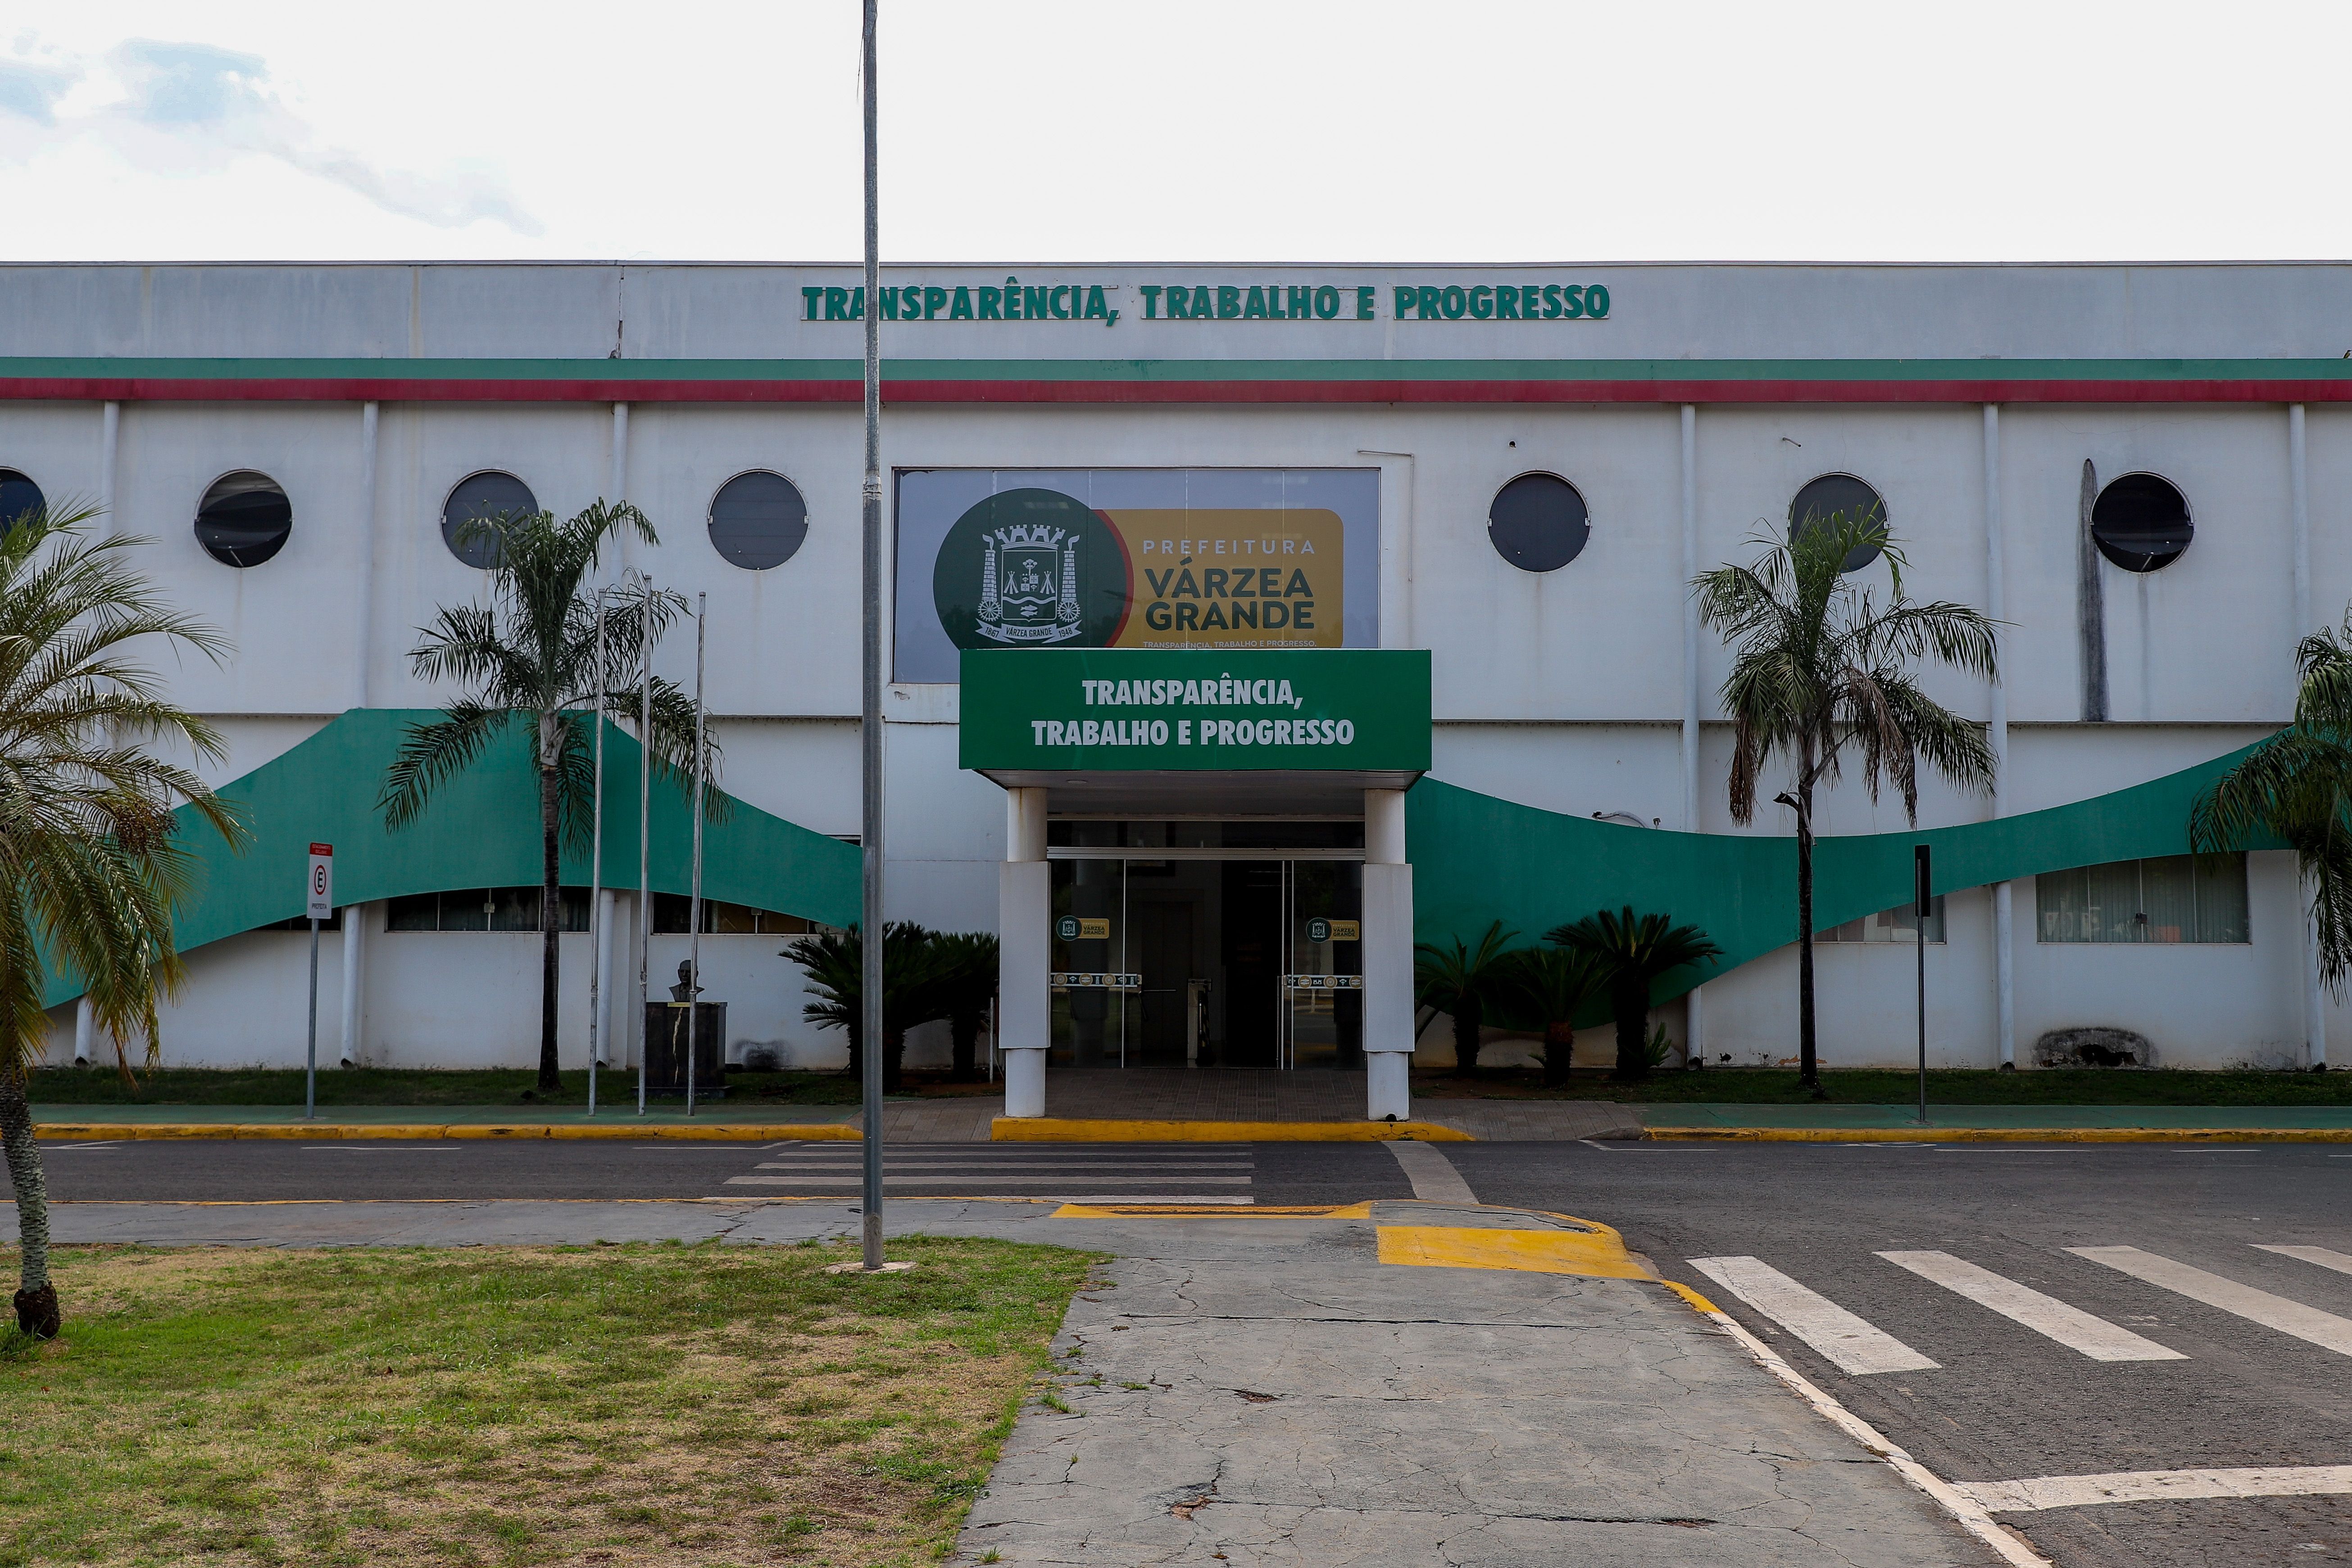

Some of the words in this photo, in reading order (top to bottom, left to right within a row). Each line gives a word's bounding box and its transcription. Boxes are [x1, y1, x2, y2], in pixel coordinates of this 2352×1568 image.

[803, 277, 1118, 326] TRANSPARÊNCIA,
[1141, 286, 1339, 319] TRABALHO
[1358, 286, 1375, 319] E
[1396, 285, 1610, 319] PROGRESSO
[1143, 540, 1315, 554] PREFEITURA
[1144, 556, 1314, 599] VÁRZEA
[1145, 601, 1314, 631] GRANDE
[985, 627, 999, 638] 1867
[1006, 627, 1027, 637] VÁRZEA
[1029, 627, 1053, 637] GRANDE
[1058, 627, 1073, 638] 1948
[1082, 673, 1303, 709] TRANSPARÊNCIA,
[1031, 720, 1169, 745] TRABALHO
[1178, 720, 1191, 745] E
[1200, 719, 1354, 745] PROGRESSO
[318, 872, 323, 888] E
